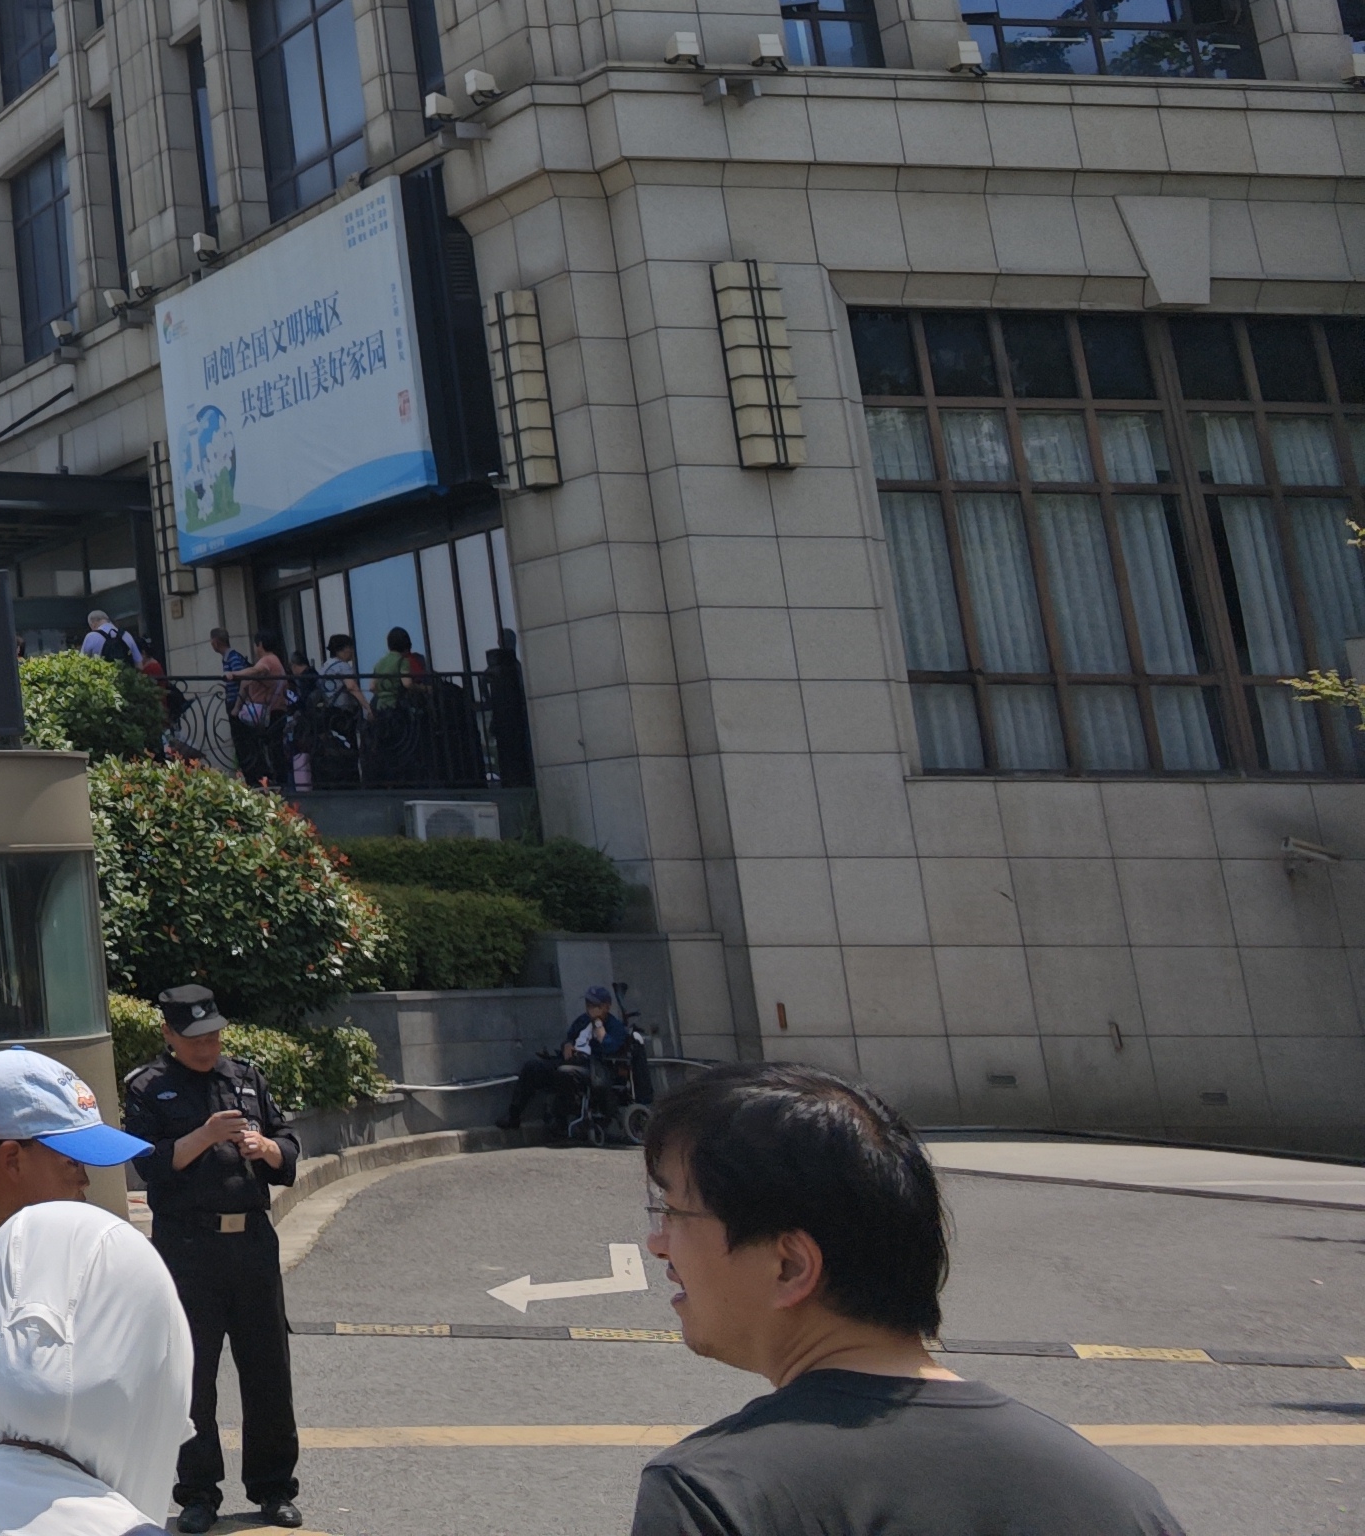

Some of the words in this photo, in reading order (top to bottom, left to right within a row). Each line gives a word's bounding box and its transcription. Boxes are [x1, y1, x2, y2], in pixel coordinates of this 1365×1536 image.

[203, 291, 343, 391] 同创全国文明城区
[240, 329, 388, 429] 共建宝山美好家园
